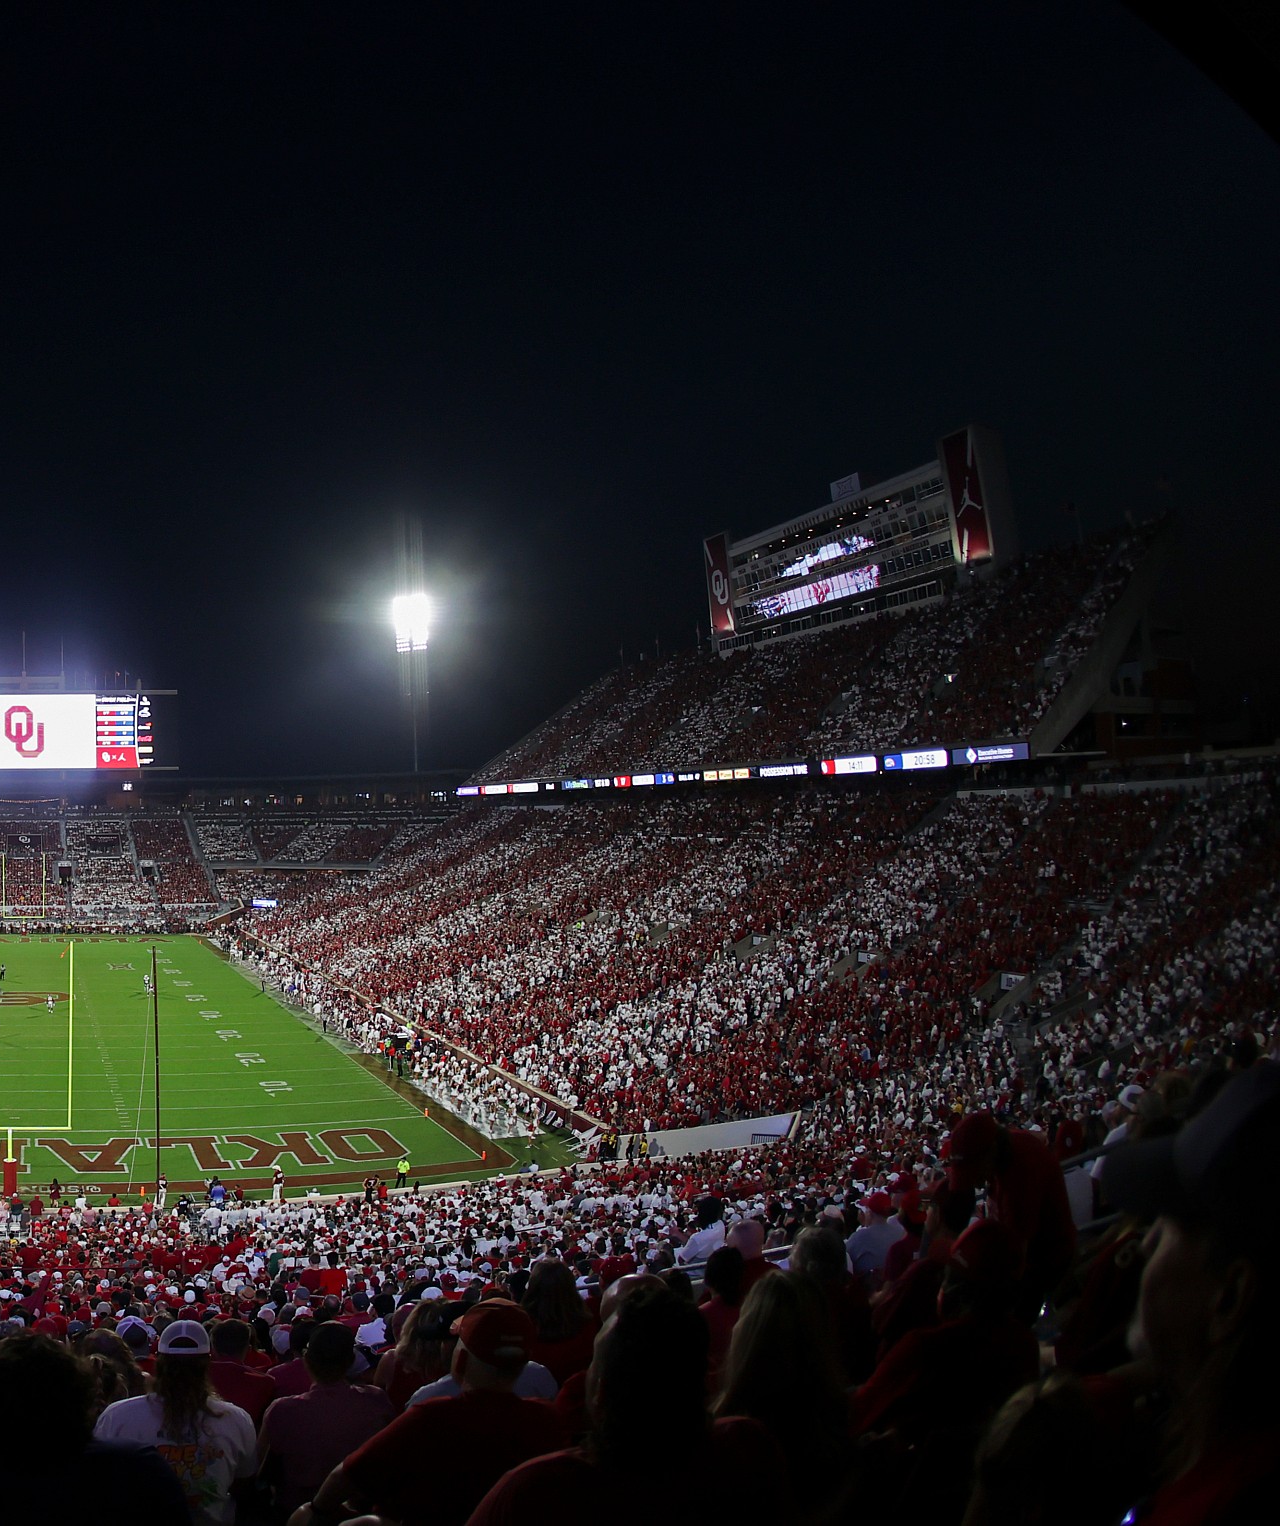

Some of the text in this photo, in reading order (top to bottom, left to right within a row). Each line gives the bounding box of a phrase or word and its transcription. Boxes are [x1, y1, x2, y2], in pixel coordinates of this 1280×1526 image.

[711, 568, 730, 605] OU
[4, 705, 44, 758] OU
[848, 760, 863, 770] 14:11
[914, 754, 936, 766] 20:58
[760, 766, 793, 777] POSSESSION
[793, 764, 808, 775] TIME
[18, 836, 31, 844] OU
[215, 1030, 243, 1039] 30
[234, 1052, 266, 1064] 20
[258, 1081, 294, 1093] 10
